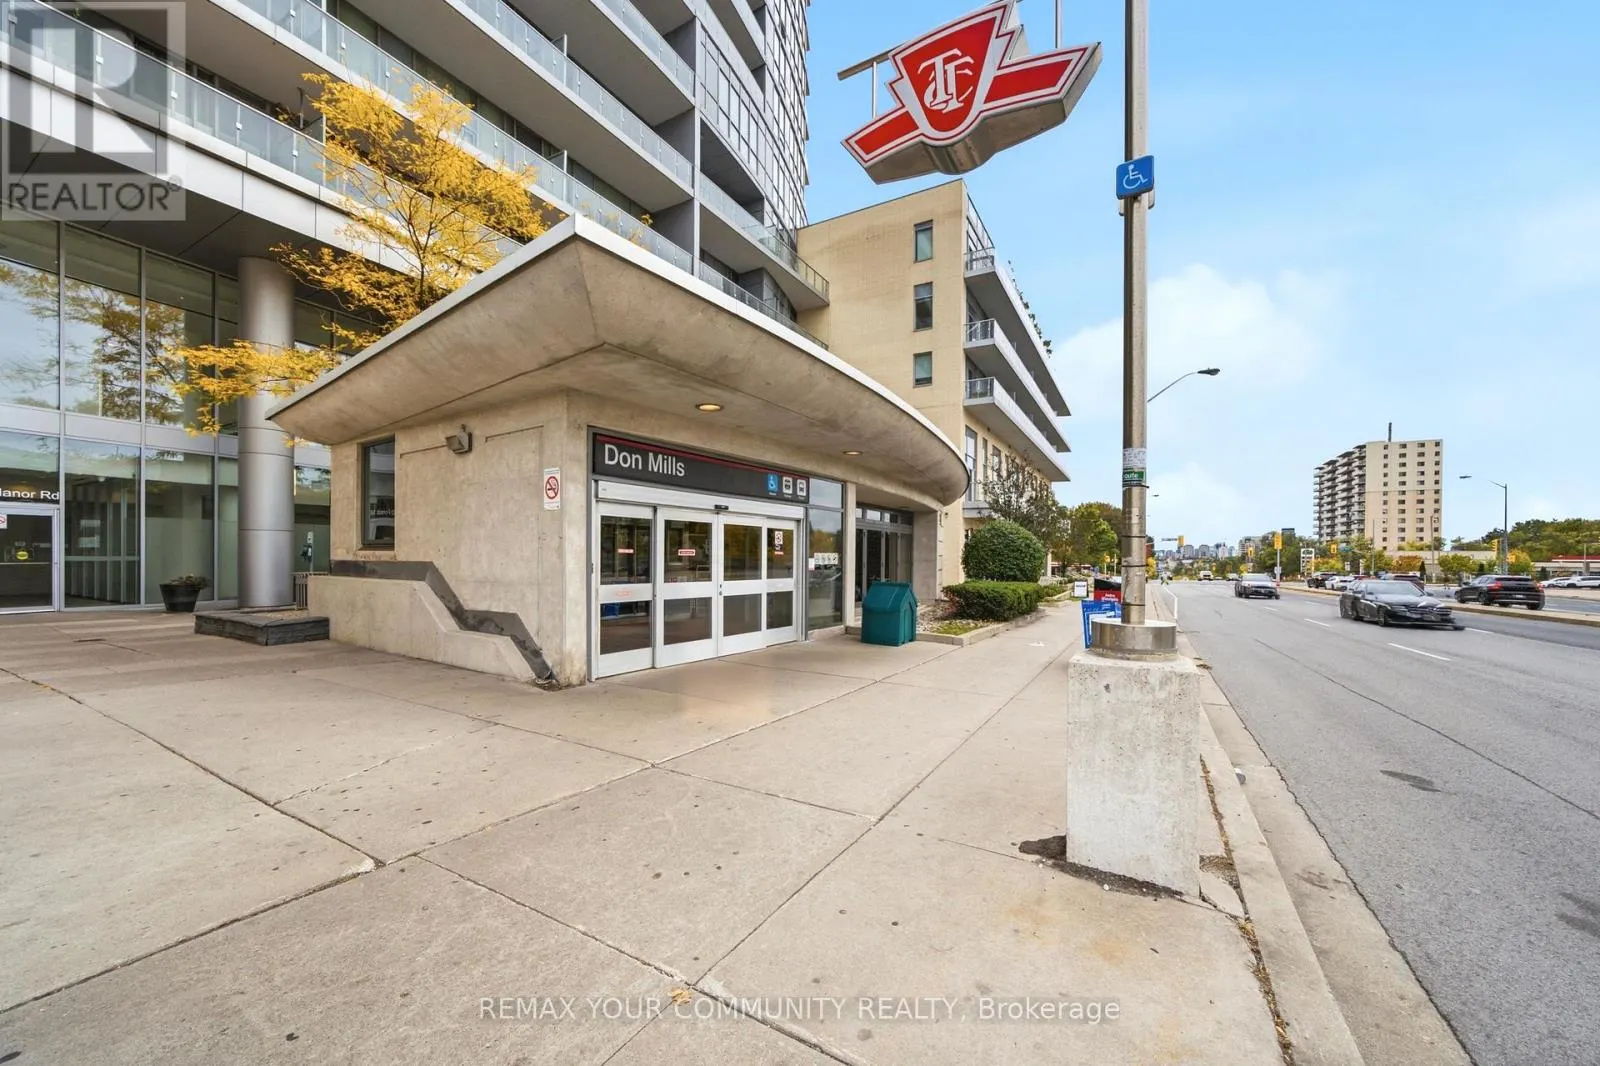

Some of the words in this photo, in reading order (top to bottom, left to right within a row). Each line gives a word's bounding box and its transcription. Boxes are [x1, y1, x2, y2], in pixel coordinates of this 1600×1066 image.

[604, 443, 643, 471] Don
[648, 451, 686, 478] Mills
[0, 488, 37, 499] anor
[40, 490, 60, 500] Rd
